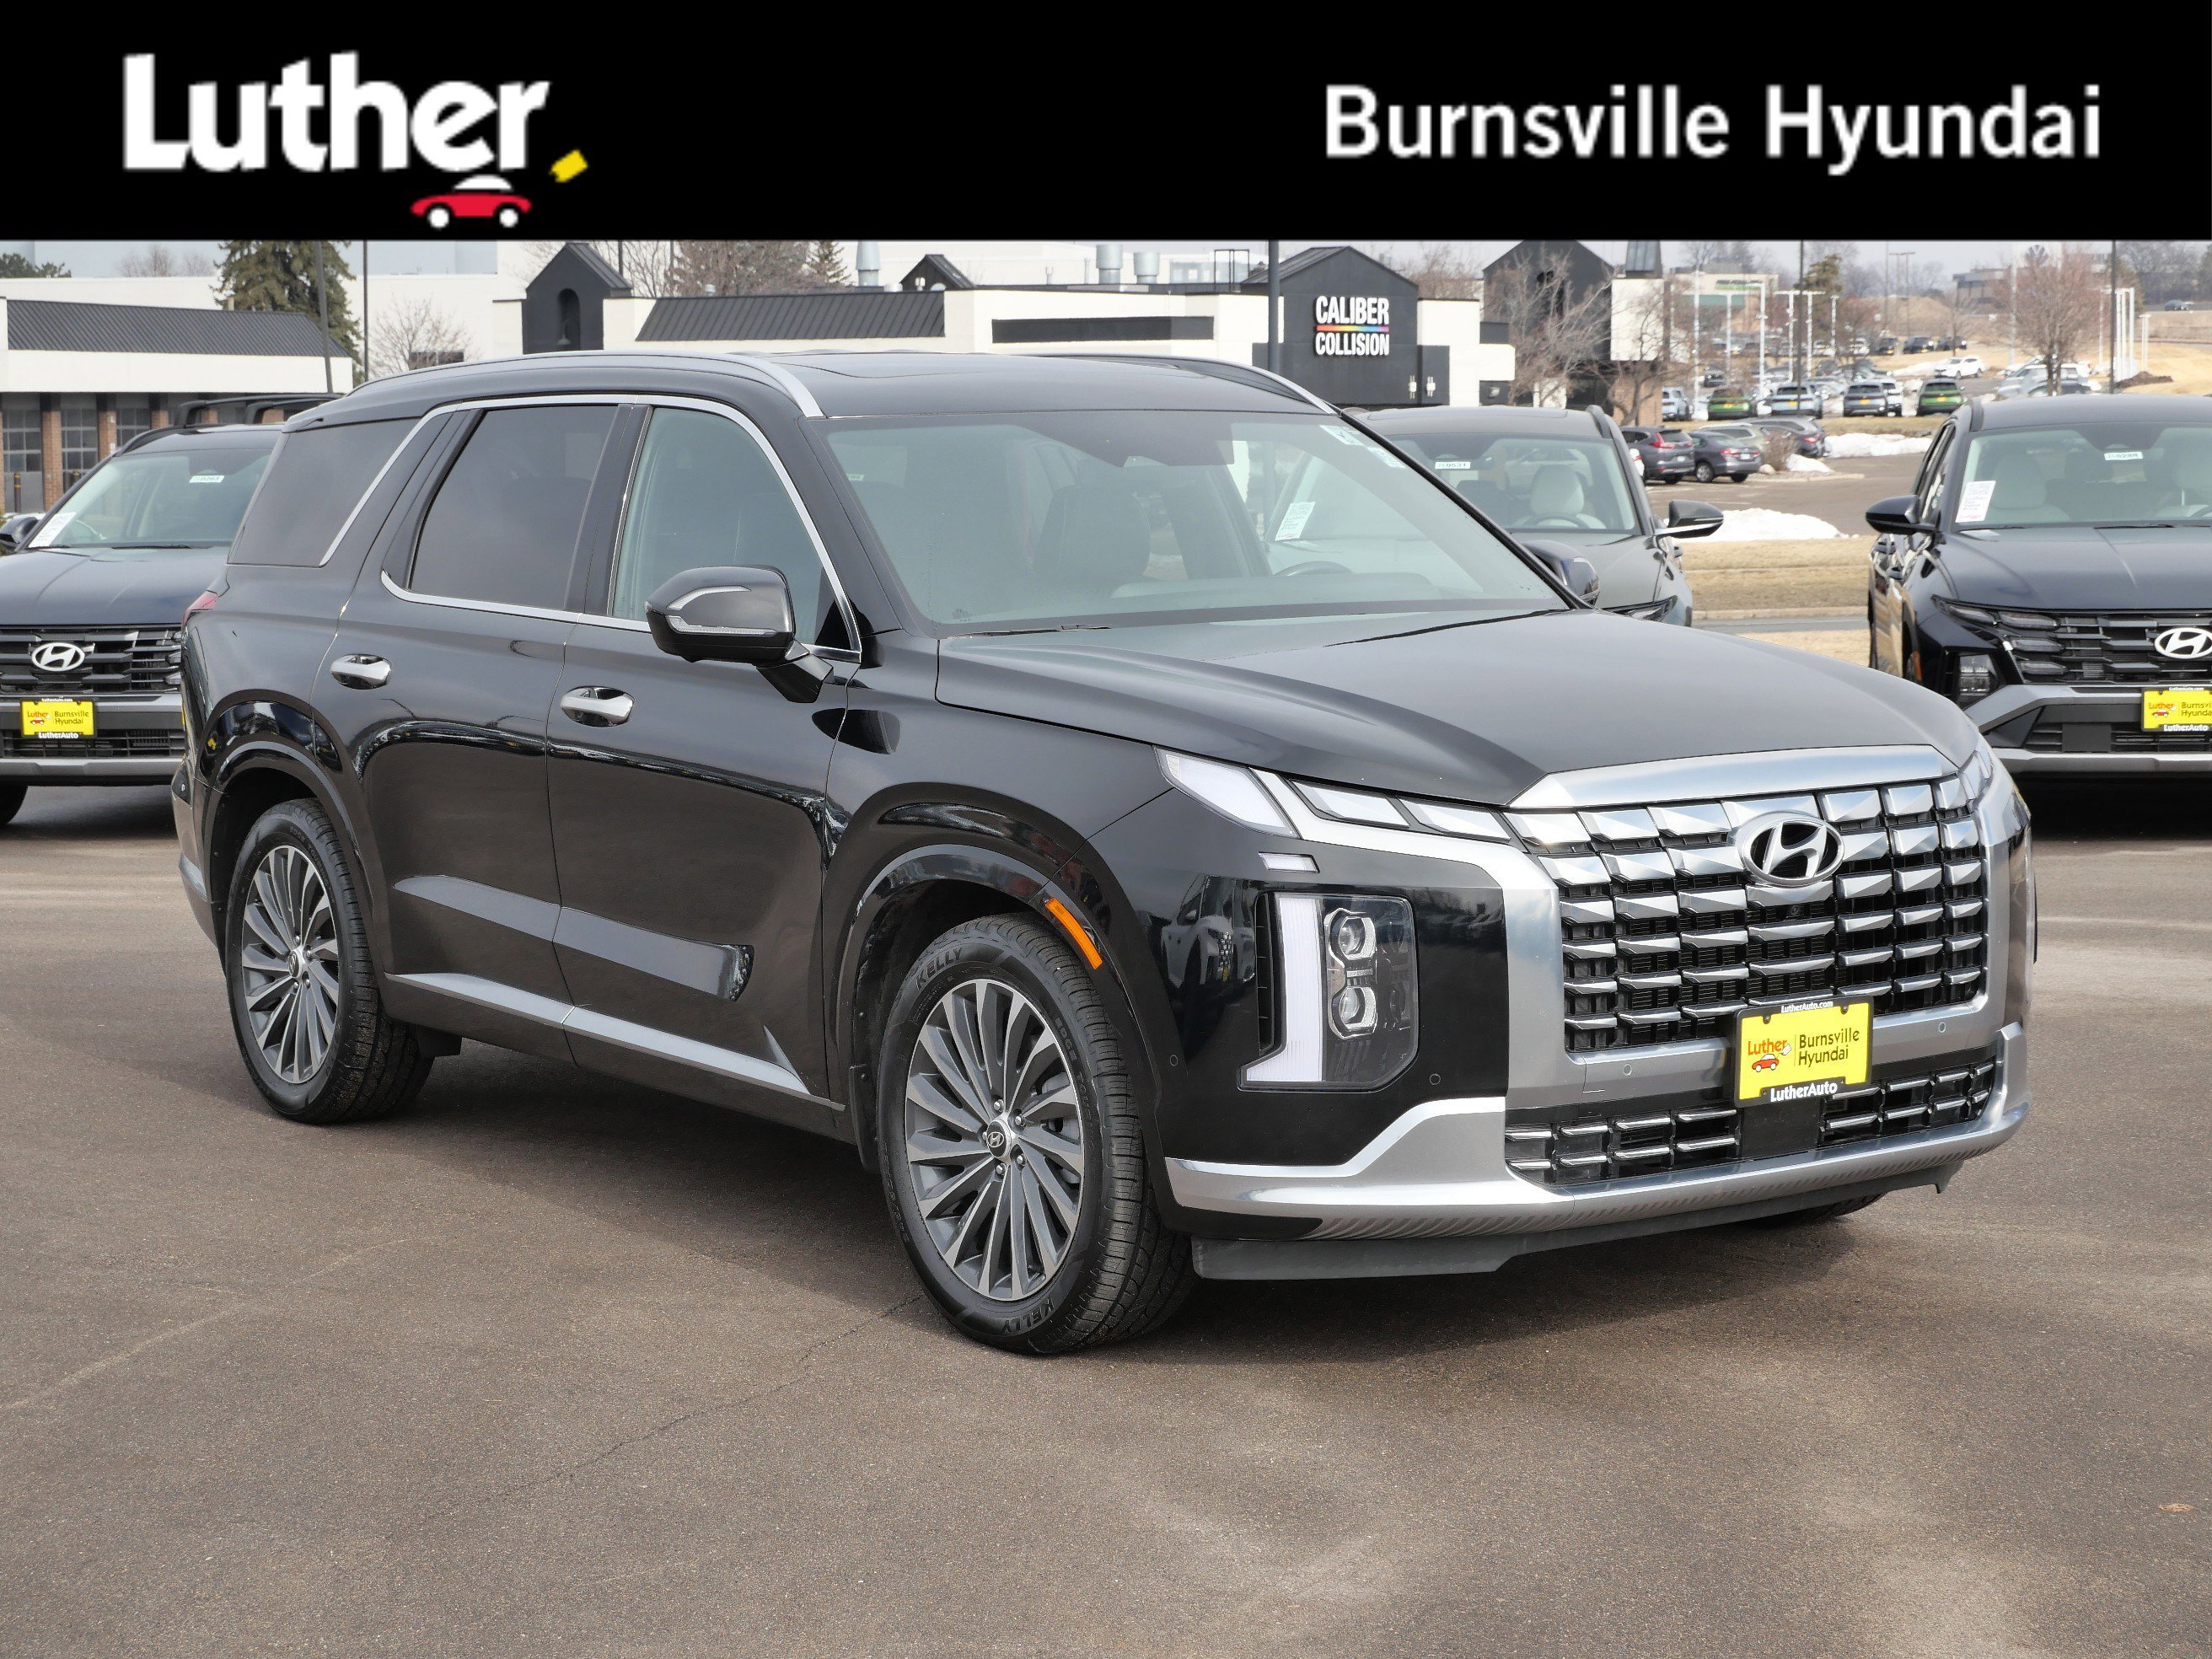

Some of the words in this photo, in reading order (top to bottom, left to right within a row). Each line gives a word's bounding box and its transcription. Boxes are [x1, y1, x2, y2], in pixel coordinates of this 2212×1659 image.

[1315, 295, 1390, 325] CALIBER
[1315, 332, 1390, 356] COLLISION
[915, 946, 962, 991] KELLY
[1780, 1001, 1833, 1013] LutherAuto.com
[1748, 1039, 1788, 1055] Luther
[1799, 1027, 1860, 1049] Burnsville
[1798, 1044, 1849, 1068] Hyundai
[1770, 1082, 1838, 1103] LutherAuto
[1002, 1297, 1055, 1333] KELLY
